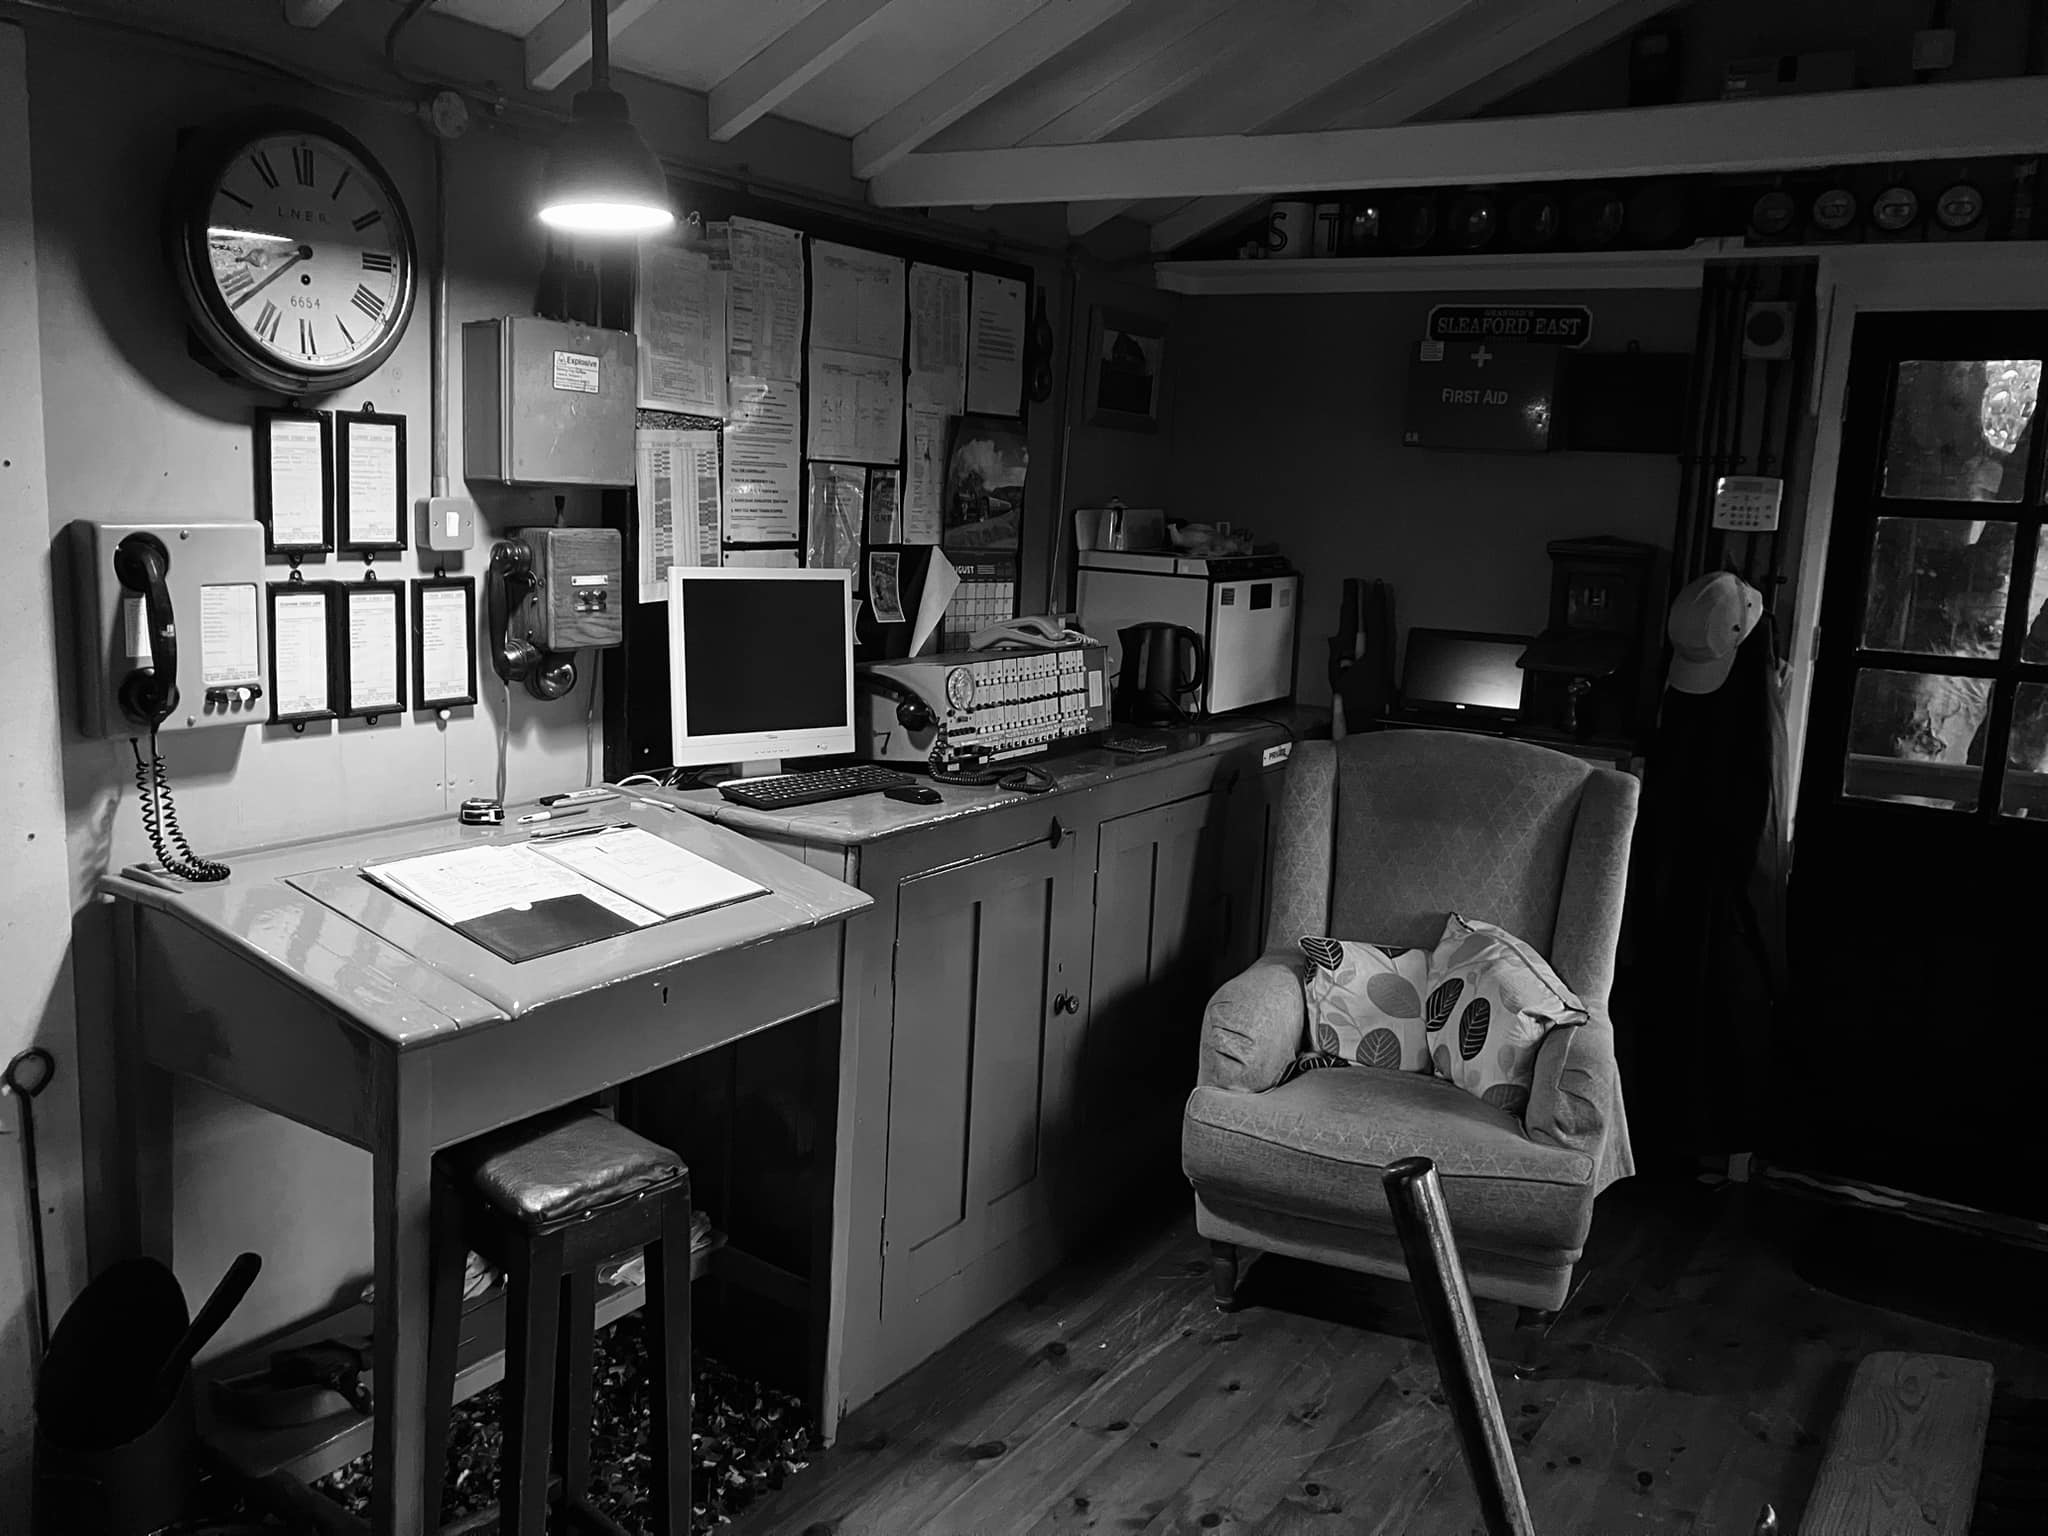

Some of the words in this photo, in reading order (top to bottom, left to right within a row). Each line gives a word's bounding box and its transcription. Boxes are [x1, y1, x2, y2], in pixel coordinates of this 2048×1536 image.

[290, 295, 321, 310] 6654
[1437, 317, 1530, 335] SLEAFORD
[1535, 318, 1582, 336] EAST
[1441, 387, 1480, 404] FIRST
[1483, 388, 1509, 405] AID
